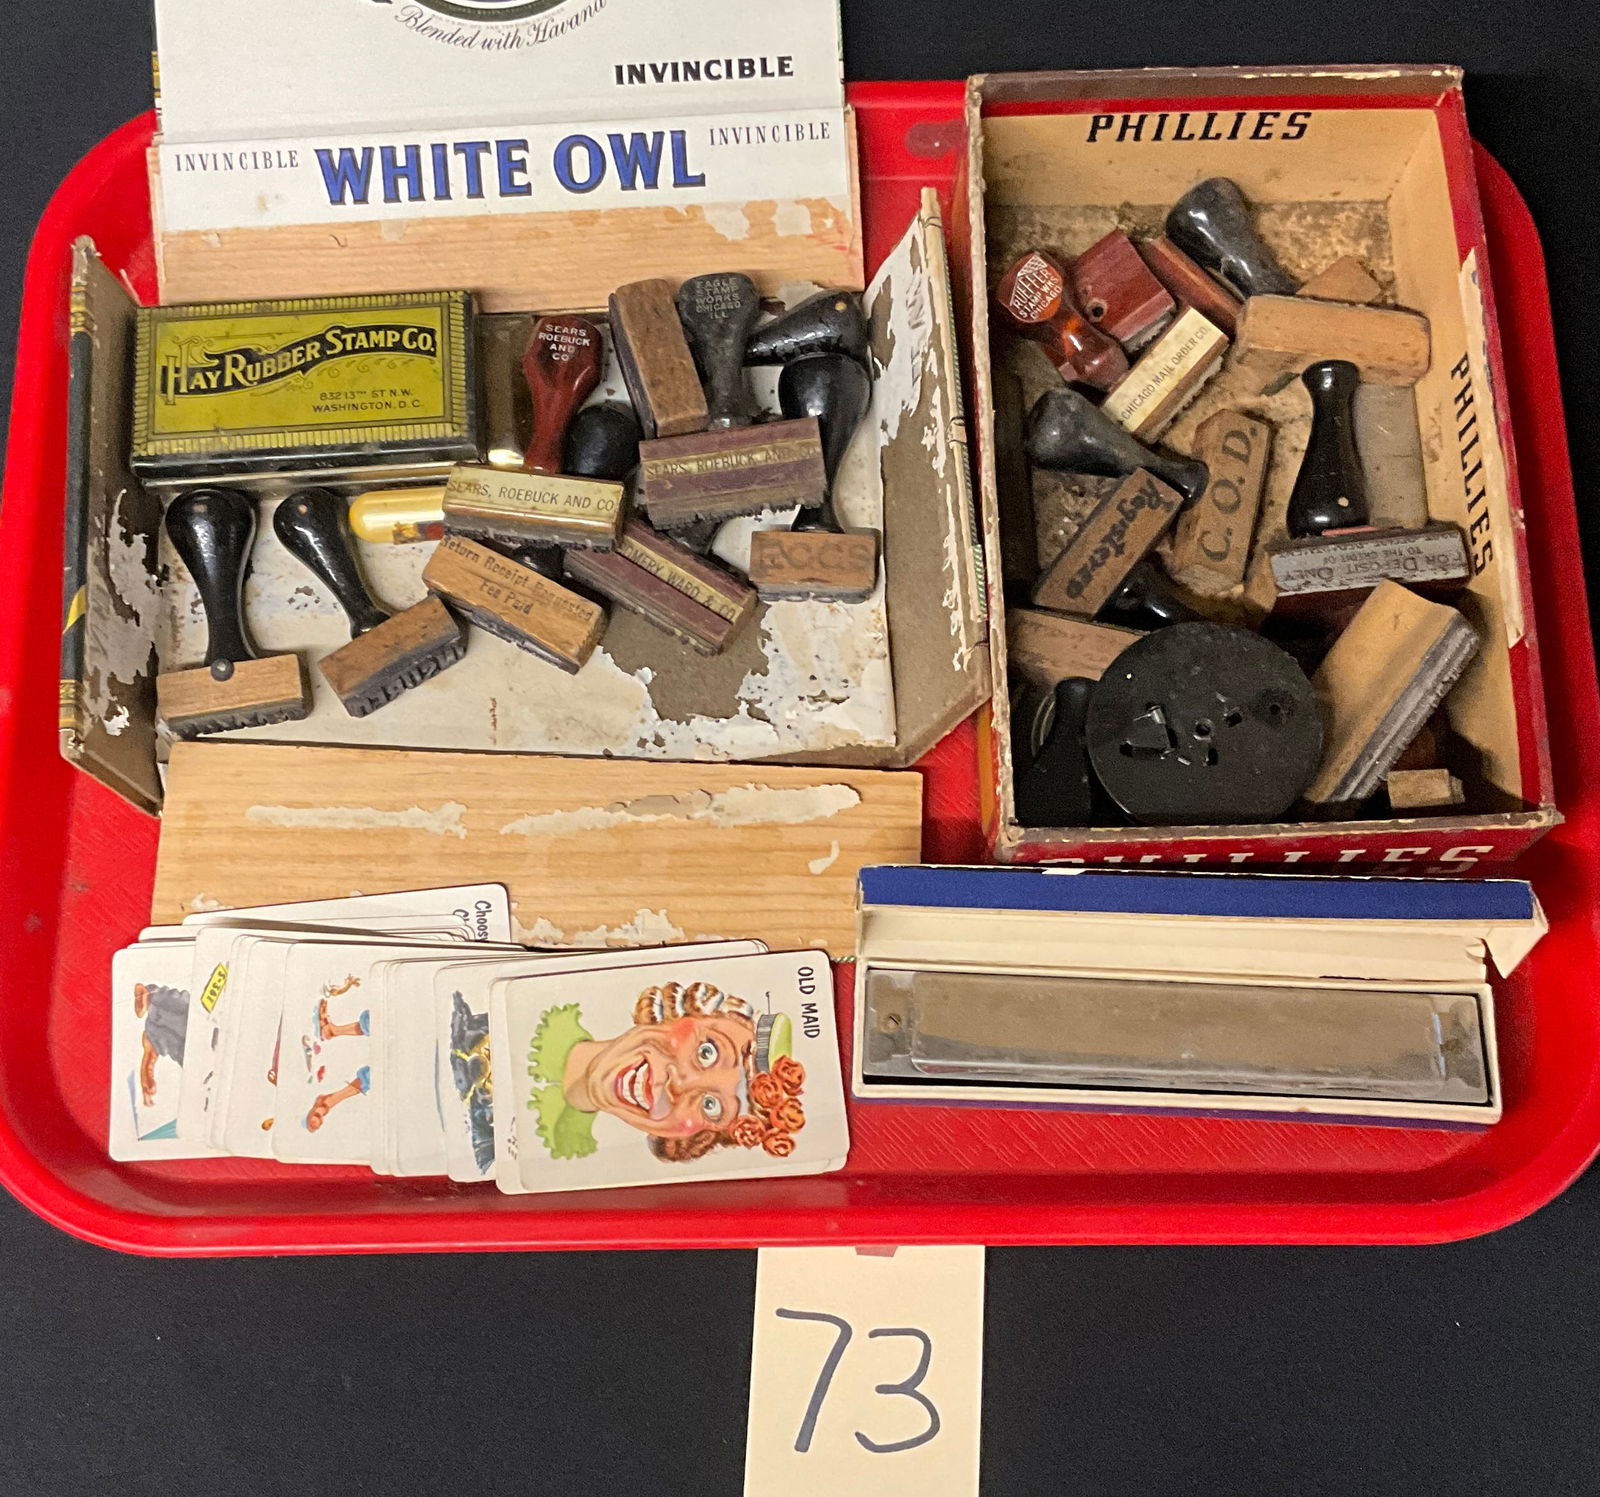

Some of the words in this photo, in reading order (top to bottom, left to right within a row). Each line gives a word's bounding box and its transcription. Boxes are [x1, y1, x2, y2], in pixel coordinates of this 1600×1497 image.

[394, 4, 481, 50] Blended
[480, 29, 525, 51] with
[614, 56, 794, 86] INVINCIBLE
[709, 121, 831, 146] INVINCIBLE
[1086, 111, 1313, 143] PHILLIES
[174, 149, 300, 173] INVINCIBLE
[314, 138, 533, 206] WHITE
[553, 129, 706, 195] OWL
[1012, 268, 1051, 309] RUEFFER
[1029, 285, 1062, 320] CHICAGO
[538, 332, 590, 347] ROEBUCK
[545, 323, 587, 337] SEARS
[550, 343, 576, 354] AND
[552, 352, 570, 362] CO
[163, 337, 222, 406] HAY
[223, 340, 322, 388] RUBBER
[324, 327, 401, 356] STAMP
[401, 327, 436, 352] CO.
[1120, 384, 1156, 421] CHICAGO
[1152, 364, 1176, 387] MAIL
[1171, 337, 1200, 366] ORDER
[320, 391, 342, 402] 832
[696, 453, 756, 473] ROEBUCK
[1449, 350, 1496, 577] PHILLIES
[447, 480, 492, 498] SEARS,
[498, 486, 560, 505] ROEBUCK
[564, 495, 592, 509] AND
[483, 556, 530, 588] Receipt
[1425, 551, 1465, 567] FOR
[622, 543, 665, 574] OMERY
[667, 571, 701, 598] WARD
[703, 595, 714, 608] &
[479, 580, 501, 600] Fee
[503, 591, 534, 615] Paid
[474, 900, 493, 940] Choos
[797, 966, 816, 995] OLD
[800, 1003, 821, 1038] MAID
[776, 1307, 941, 1453] 73
